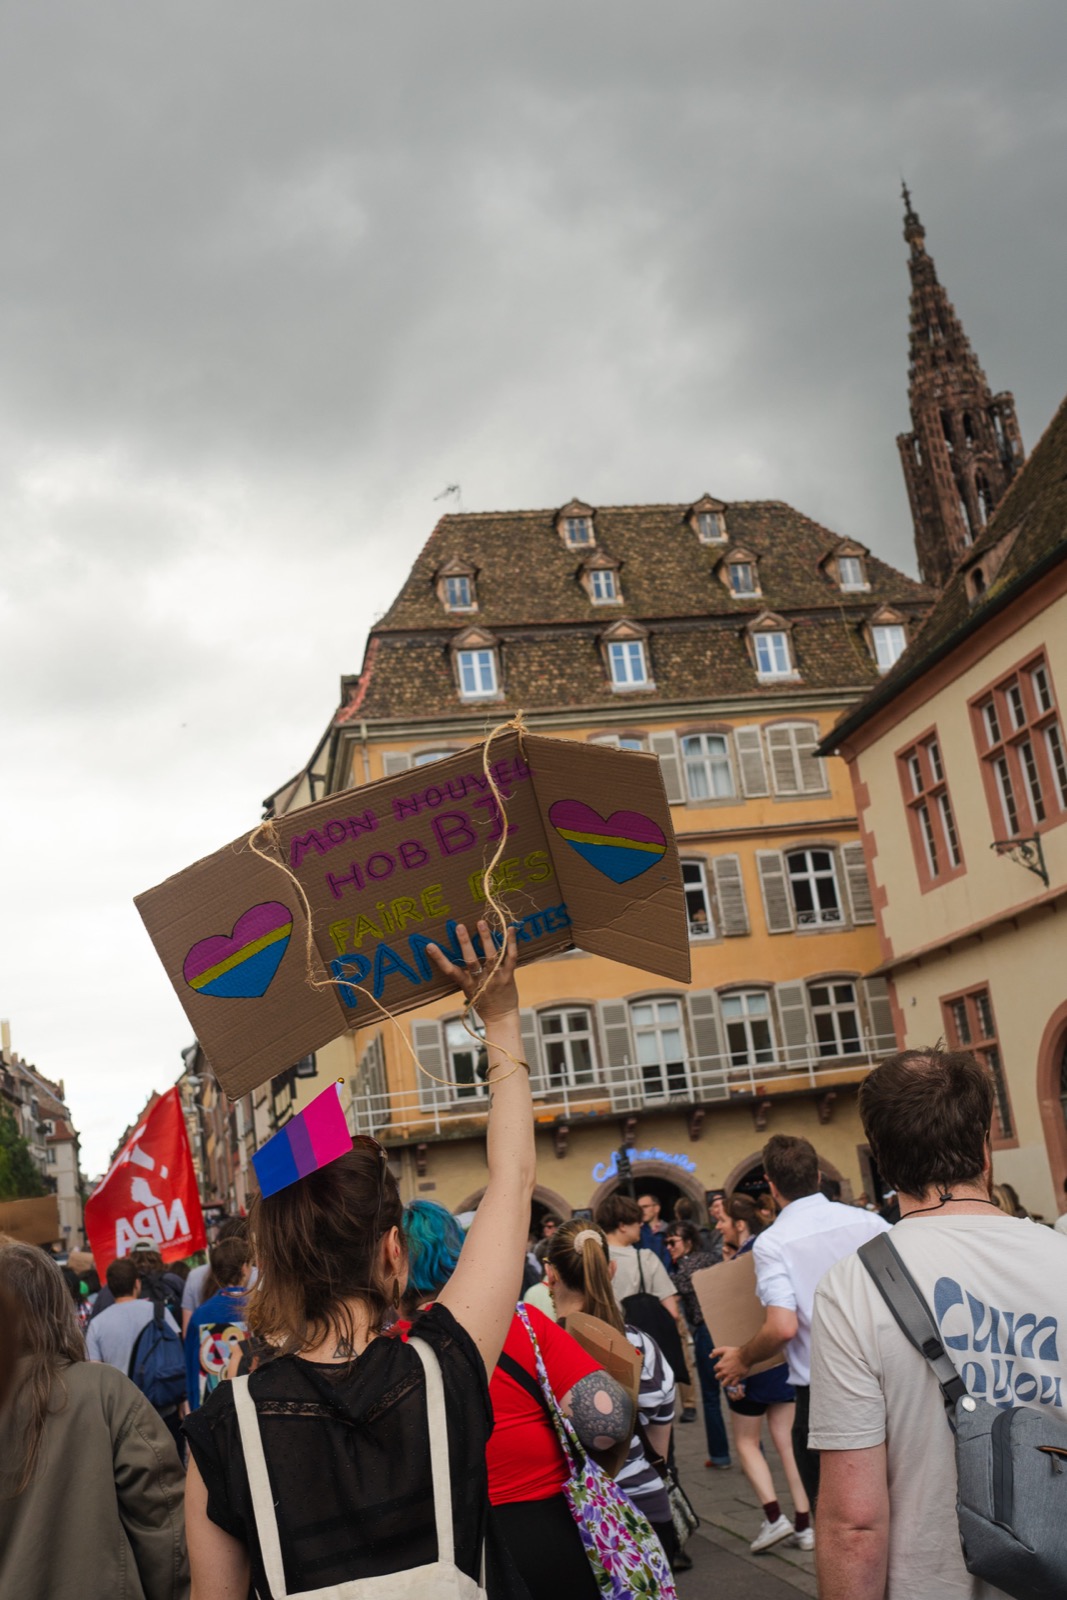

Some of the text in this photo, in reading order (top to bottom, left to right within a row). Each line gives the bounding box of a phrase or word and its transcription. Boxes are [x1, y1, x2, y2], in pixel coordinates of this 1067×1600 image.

[290, 755, 534, 868] MON NOUVEL
[467, 850, 551, 902] DES
[933, 1277, 1059, 1362] Cum
[991, 1359, 1063, 1410] you
